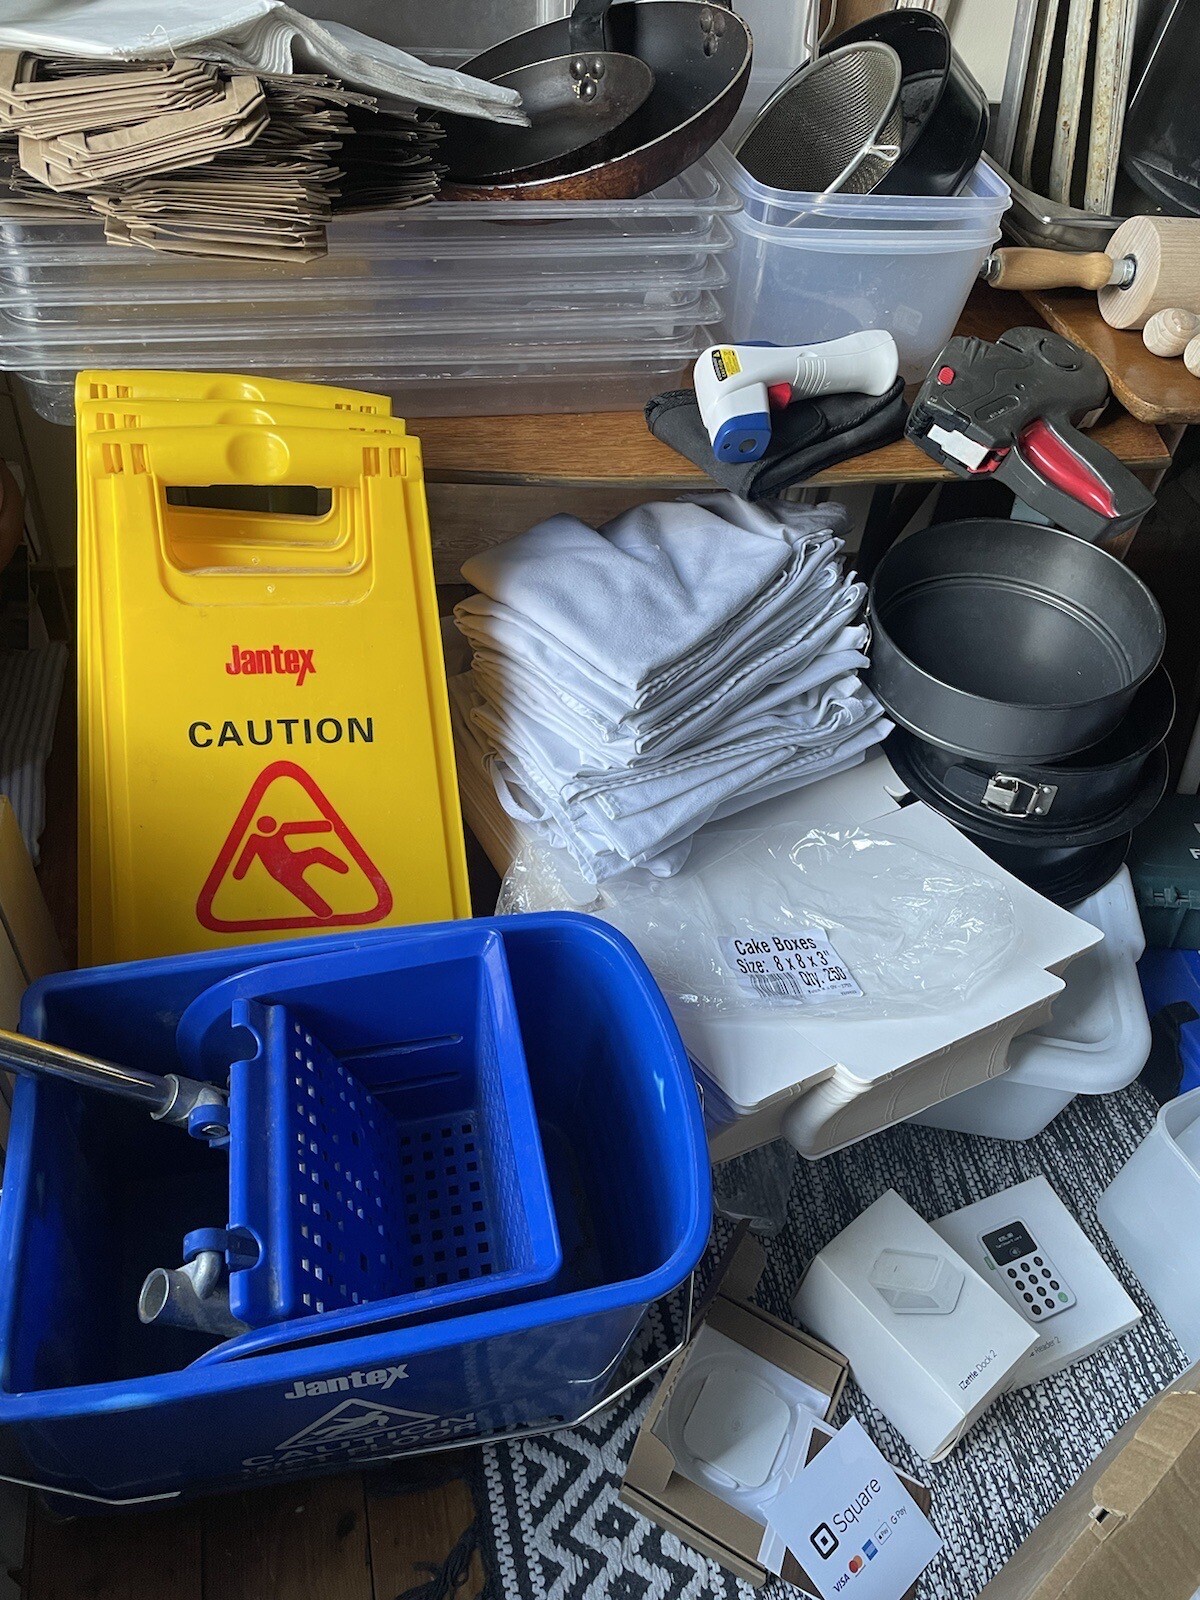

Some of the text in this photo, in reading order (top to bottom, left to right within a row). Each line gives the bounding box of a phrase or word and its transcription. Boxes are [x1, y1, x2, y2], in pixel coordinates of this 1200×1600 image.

[225, 645, 316, 686] Jantex
[188, 717, 374, 747] CAUTION
[734, 936, 817, 956] Cake Boxes
[736, 958, 769, 974] Size:
[773, 955, 784, 972] 8
[785, 958, 796, 971] x
[795, 953, 806, 969] 8
[807, 956, 818, 968] x
[799, 966, 847, 988] Qty. 250
[284, 1363, 409, 1399] Jantex
[958, 1349, 997, 1391] iZettle Dock 2
[242, 1412, 475, 1466] CAUTION
[347, 1421, 477, 1456] FLOOR
[832, 1479, 881, 1533] Square
[895, 1505, 907, 1519] Pay
[833, 1573, 851, 1592] VISA
